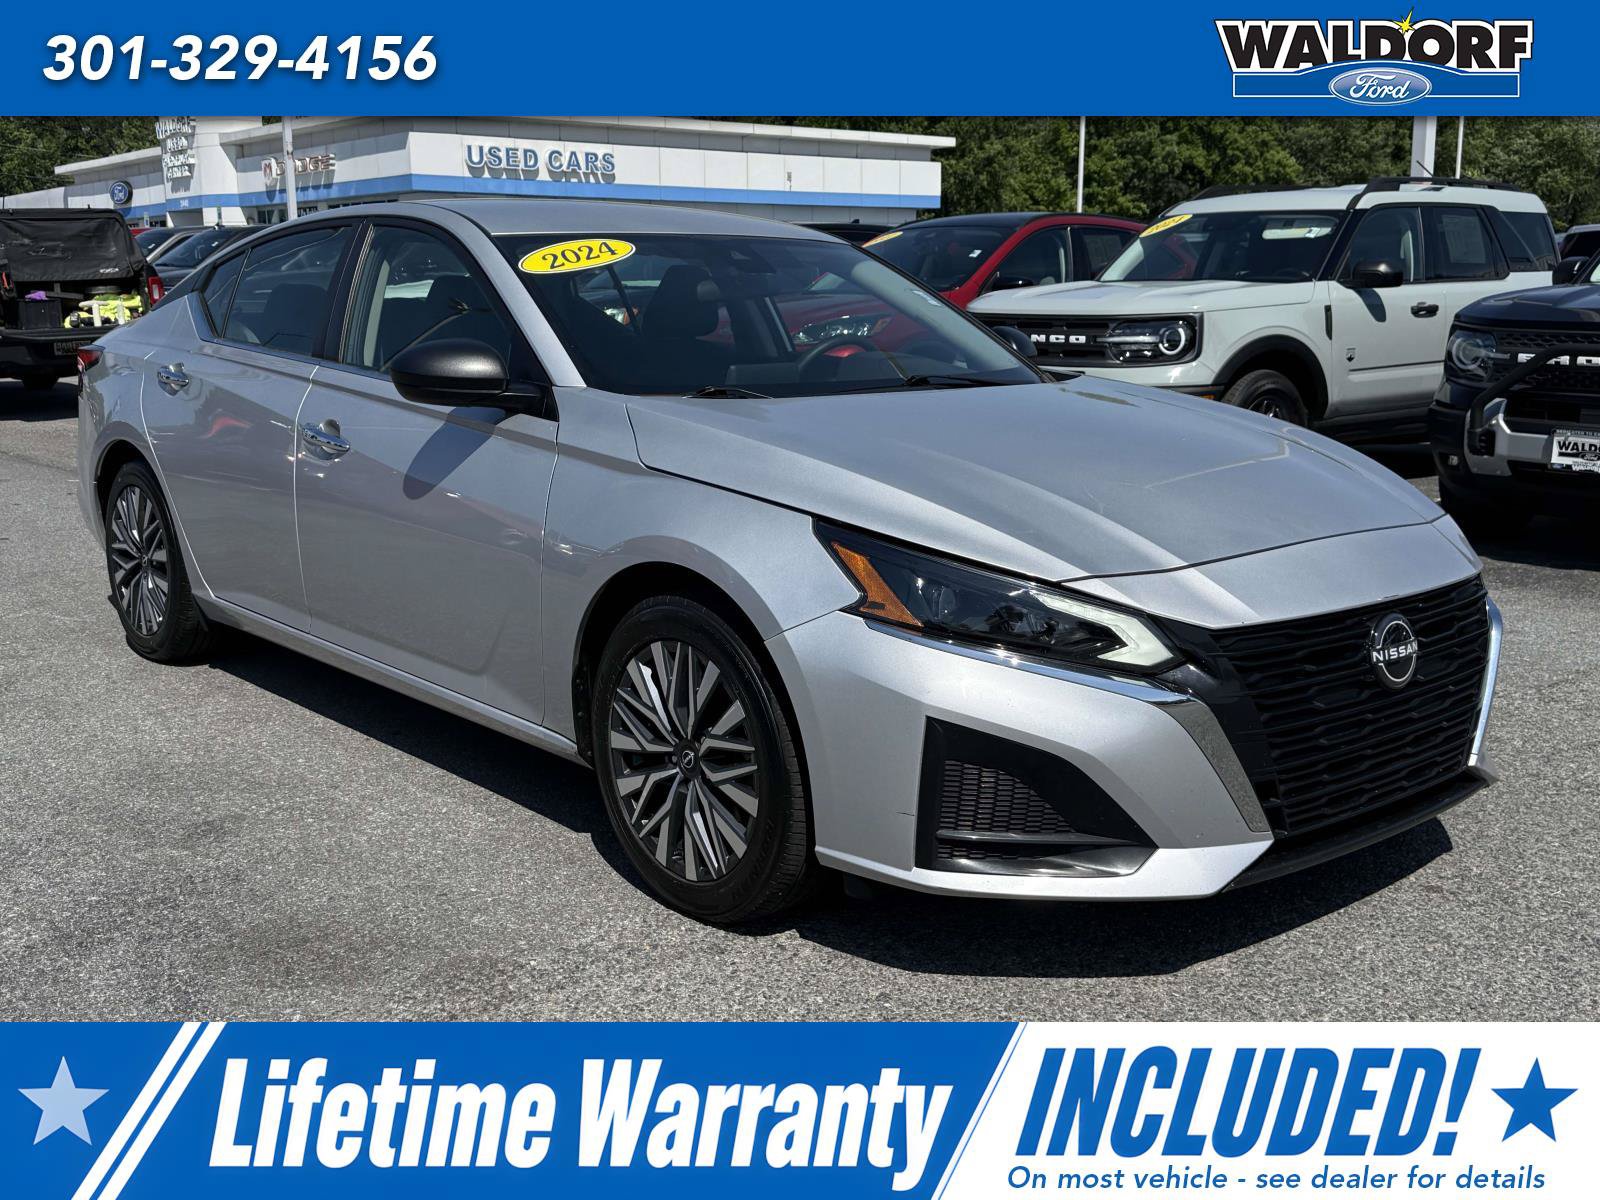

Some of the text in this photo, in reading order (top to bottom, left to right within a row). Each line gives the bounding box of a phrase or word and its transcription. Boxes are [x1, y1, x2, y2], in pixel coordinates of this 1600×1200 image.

[275, 155, 335, 177] DDGE
[466, 144, 616, 175] USED CARS
[541, 241, 619, 270] 2024
[1557, 440, 1600, 453] WALD
[1372, 641, 1418, 663] NISSAN
